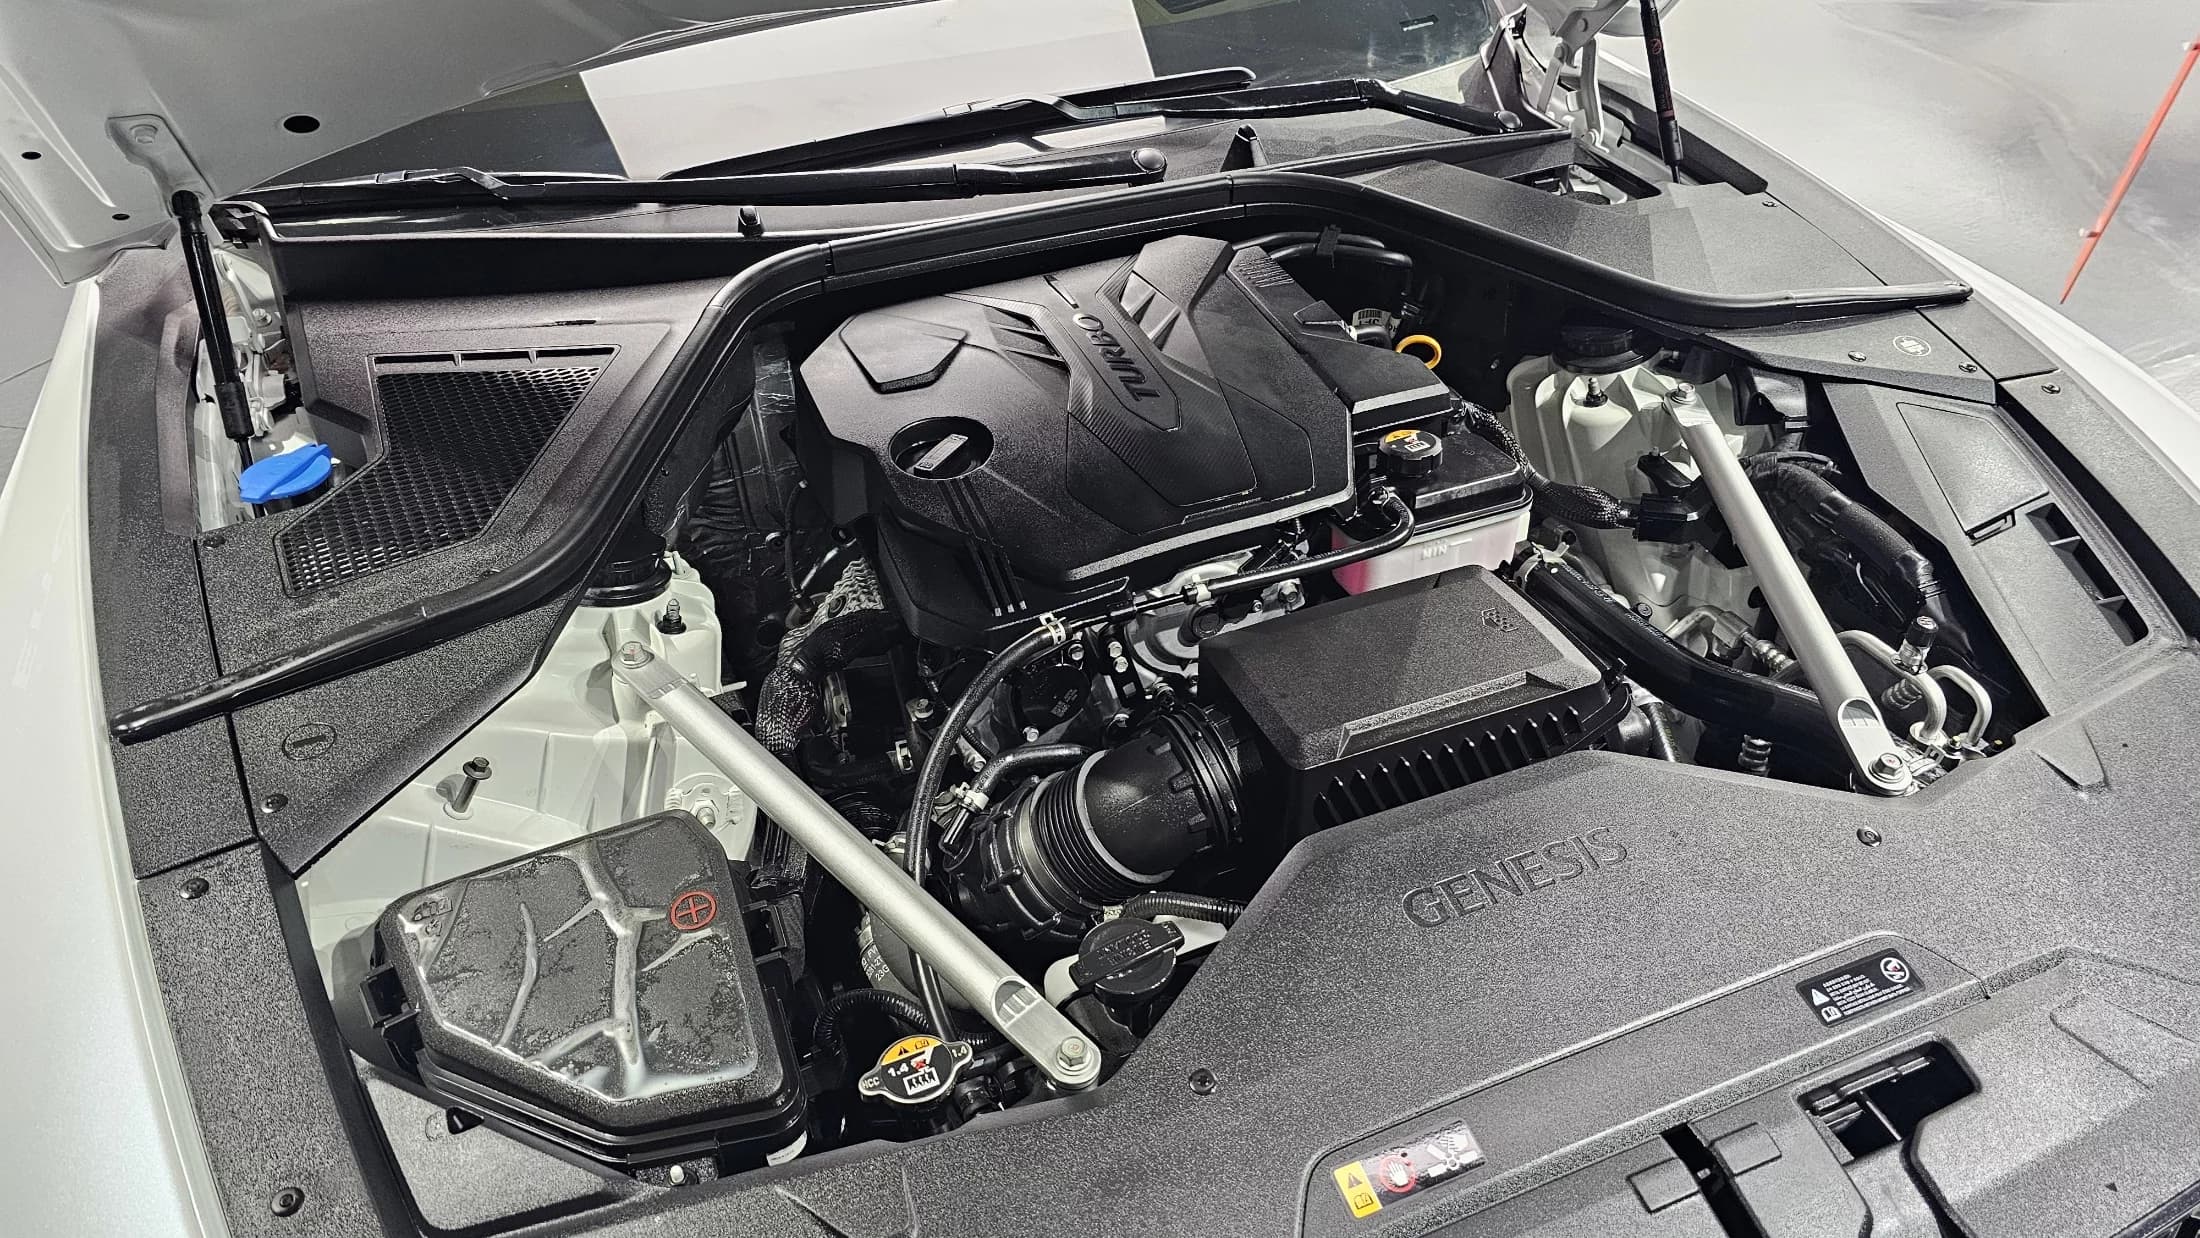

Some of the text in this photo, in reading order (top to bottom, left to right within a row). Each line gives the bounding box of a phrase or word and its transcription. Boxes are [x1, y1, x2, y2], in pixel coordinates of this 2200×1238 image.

[1072, 313, 1161, 402] TURBO
[1402, 826, 1628, 929] GENESIS
[887, 1062, 909, 1077] 1.4
[951, 1045, 968, 1058] 1.4
